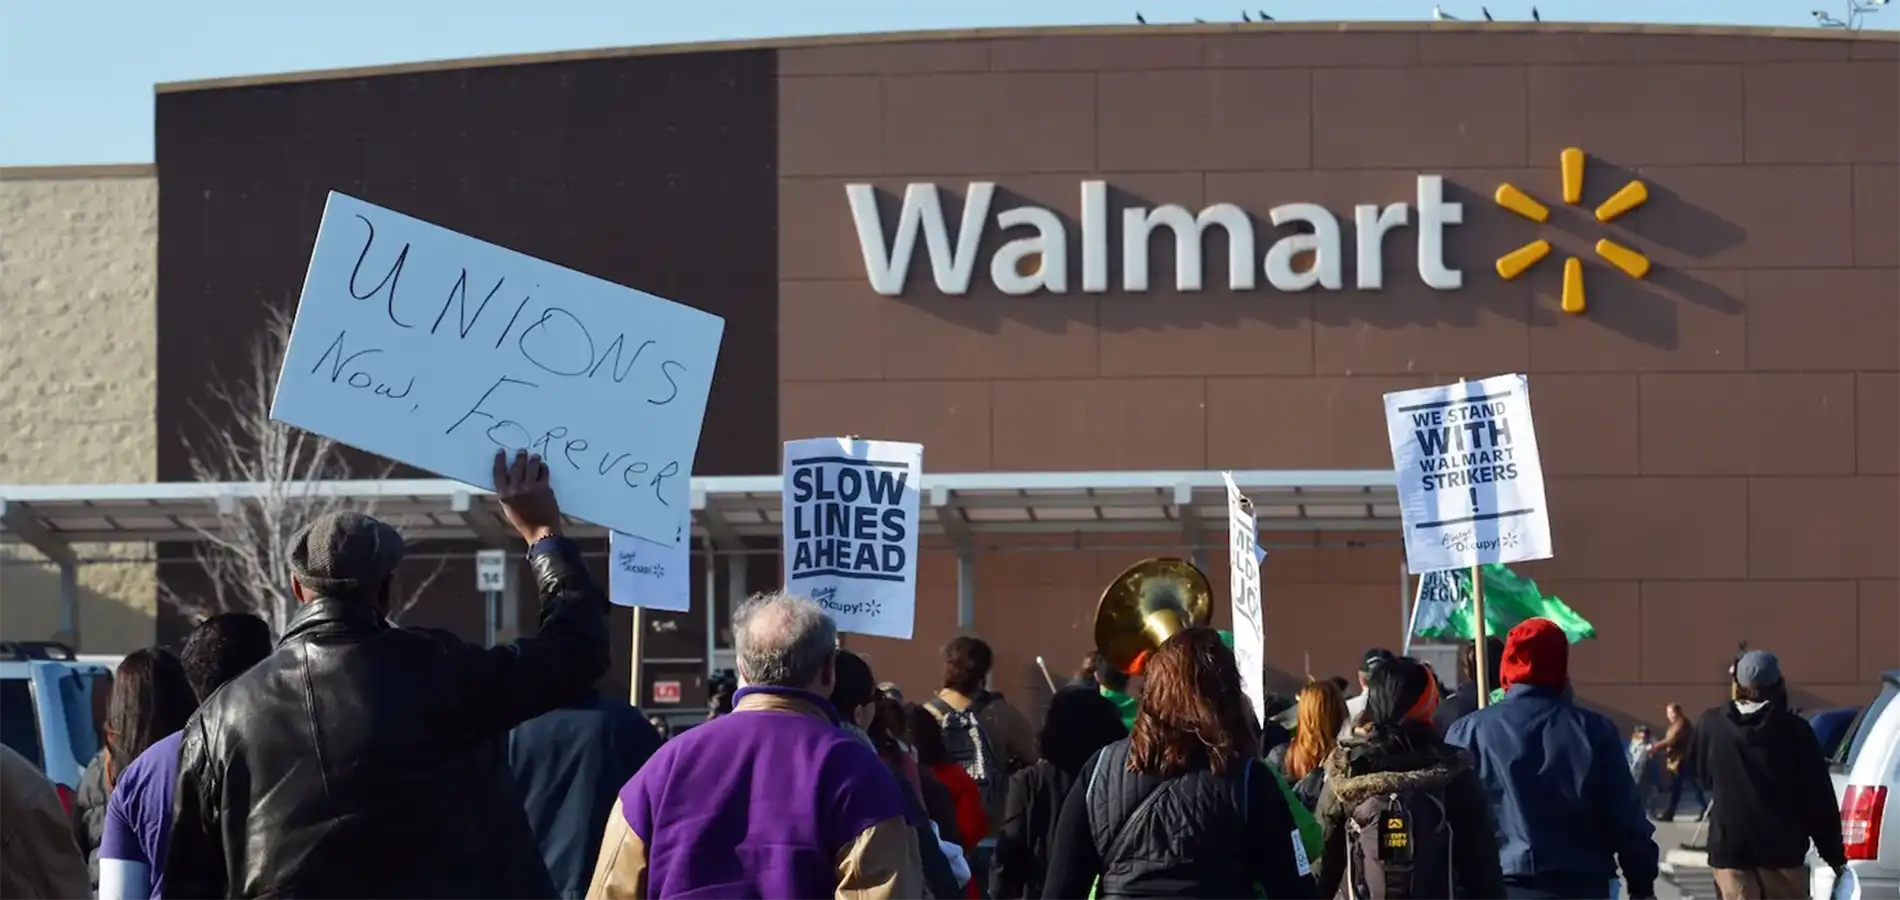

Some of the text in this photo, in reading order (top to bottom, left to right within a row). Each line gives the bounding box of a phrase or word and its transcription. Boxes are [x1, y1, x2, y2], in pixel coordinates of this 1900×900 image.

[845, 174, 1463, 296] Walmart
[1412, 401, 1506, 427] WE STAND
[1415, 417, 1512, 457] WITH
[1420, 447, 1514, 472] WALMART
[1422, 463, 1518, 491] STRIKERS
[792, 466, 908, 505] SLOW
[794, 502, 906, 542] LINES
[792, 538, 906, 572] AHEAD
